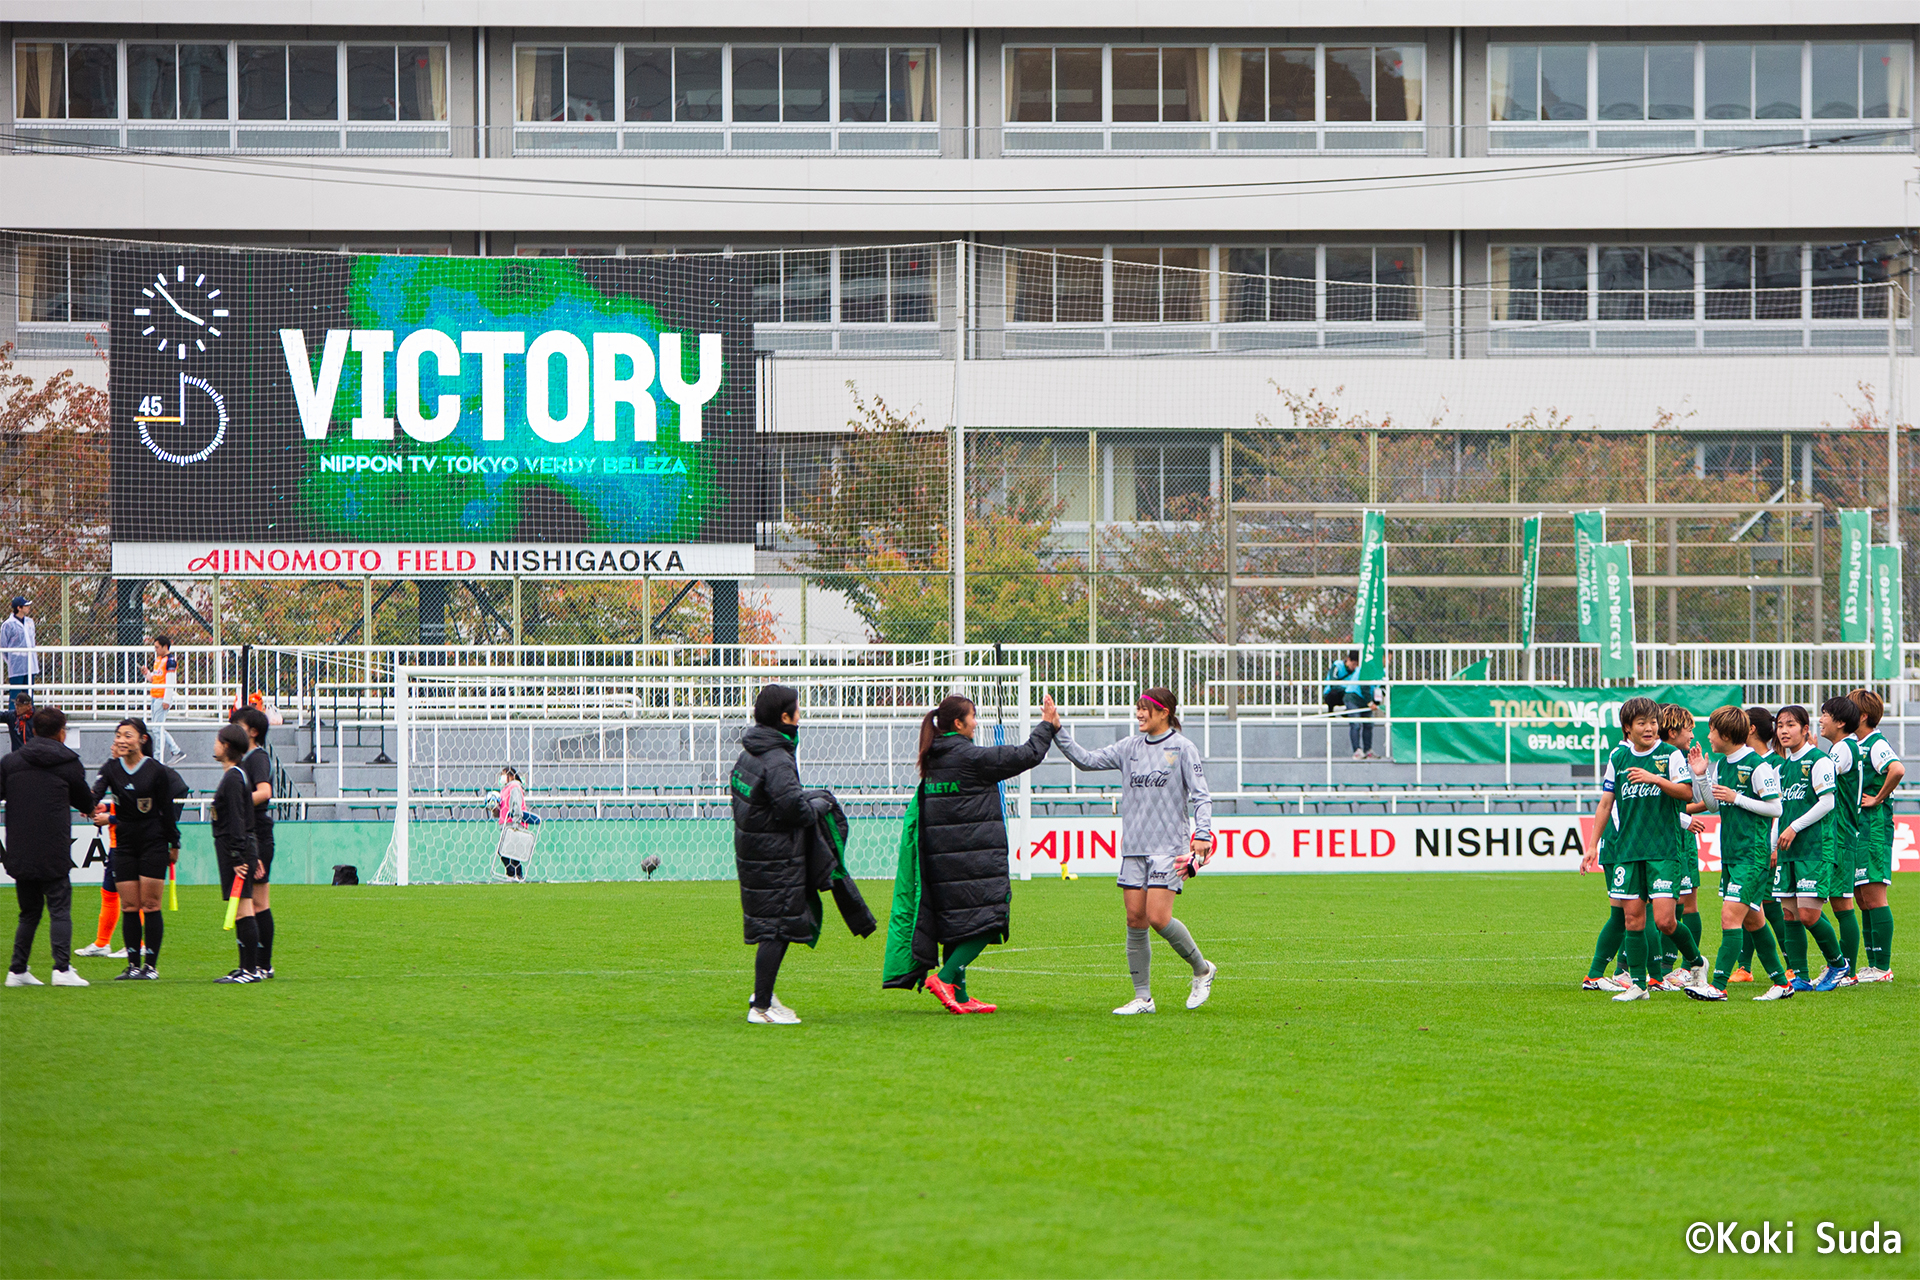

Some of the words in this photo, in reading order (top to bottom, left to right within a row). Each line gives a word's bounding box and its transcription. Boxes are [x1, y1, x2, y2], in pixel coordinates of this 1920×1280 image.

[279, 328, 722, 443] VICTORY
[138, 395, 162, 416] 45
[320, 455, 402, 473] NIPPON
[407, 455, 438, 473] TV
[442, 455, 519, 474] TOKYO
[524, 456, 597, 474] VERDY
[603, 456, 688, 474] BELEZA
[187, 549, 382, 573] AJINOMOTO
[397, 549, 476, 571] FIELD
[490, 549, 685, 572] NISHIGAOKA
[1293, 829, 1396, 857] FIELD
[1613, 866, 1626, 887] 3
